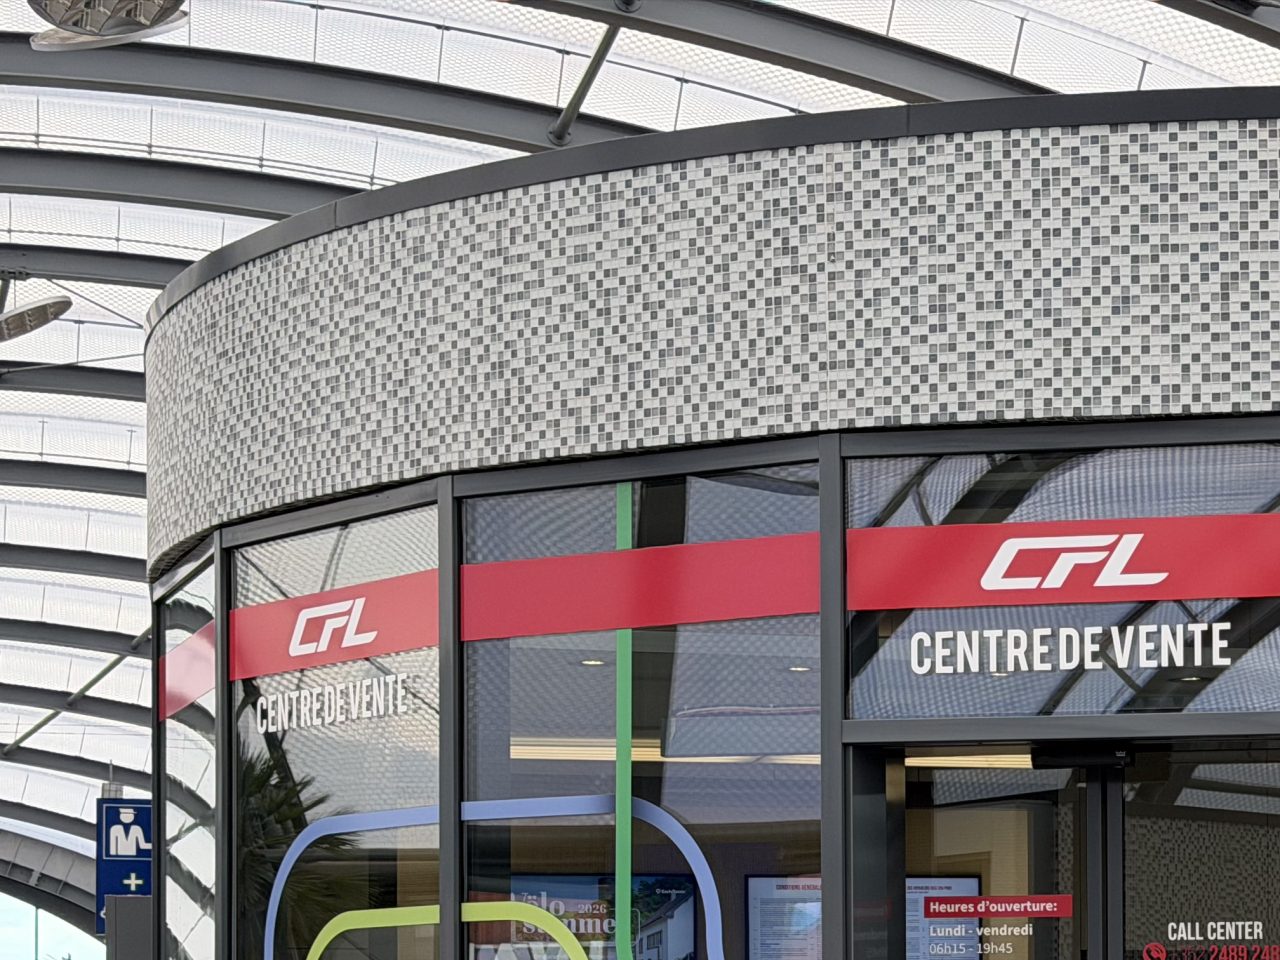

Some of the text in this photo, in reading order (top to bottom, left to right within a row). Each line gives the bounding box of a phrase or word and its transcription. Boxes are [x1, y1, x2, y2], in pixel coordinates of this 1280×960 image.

[980, 533, 1170, 591] CFL
[288, 597, 378, 657] CFL
[910, 621, 1232, 675] CENTRE DE VENTE
[256, 672, 408, 734] CENTRE DE VENTE
[578, 903, 607, 914] 2026
[929, 900, 1057, 913] Heures d'ouverture:
[929, 924, 1034, 937] Lundi vendredi
[1167, 921, 1264, 941] CALL CENTER
[929, 942, 1013, 954] 06h15 19h45
